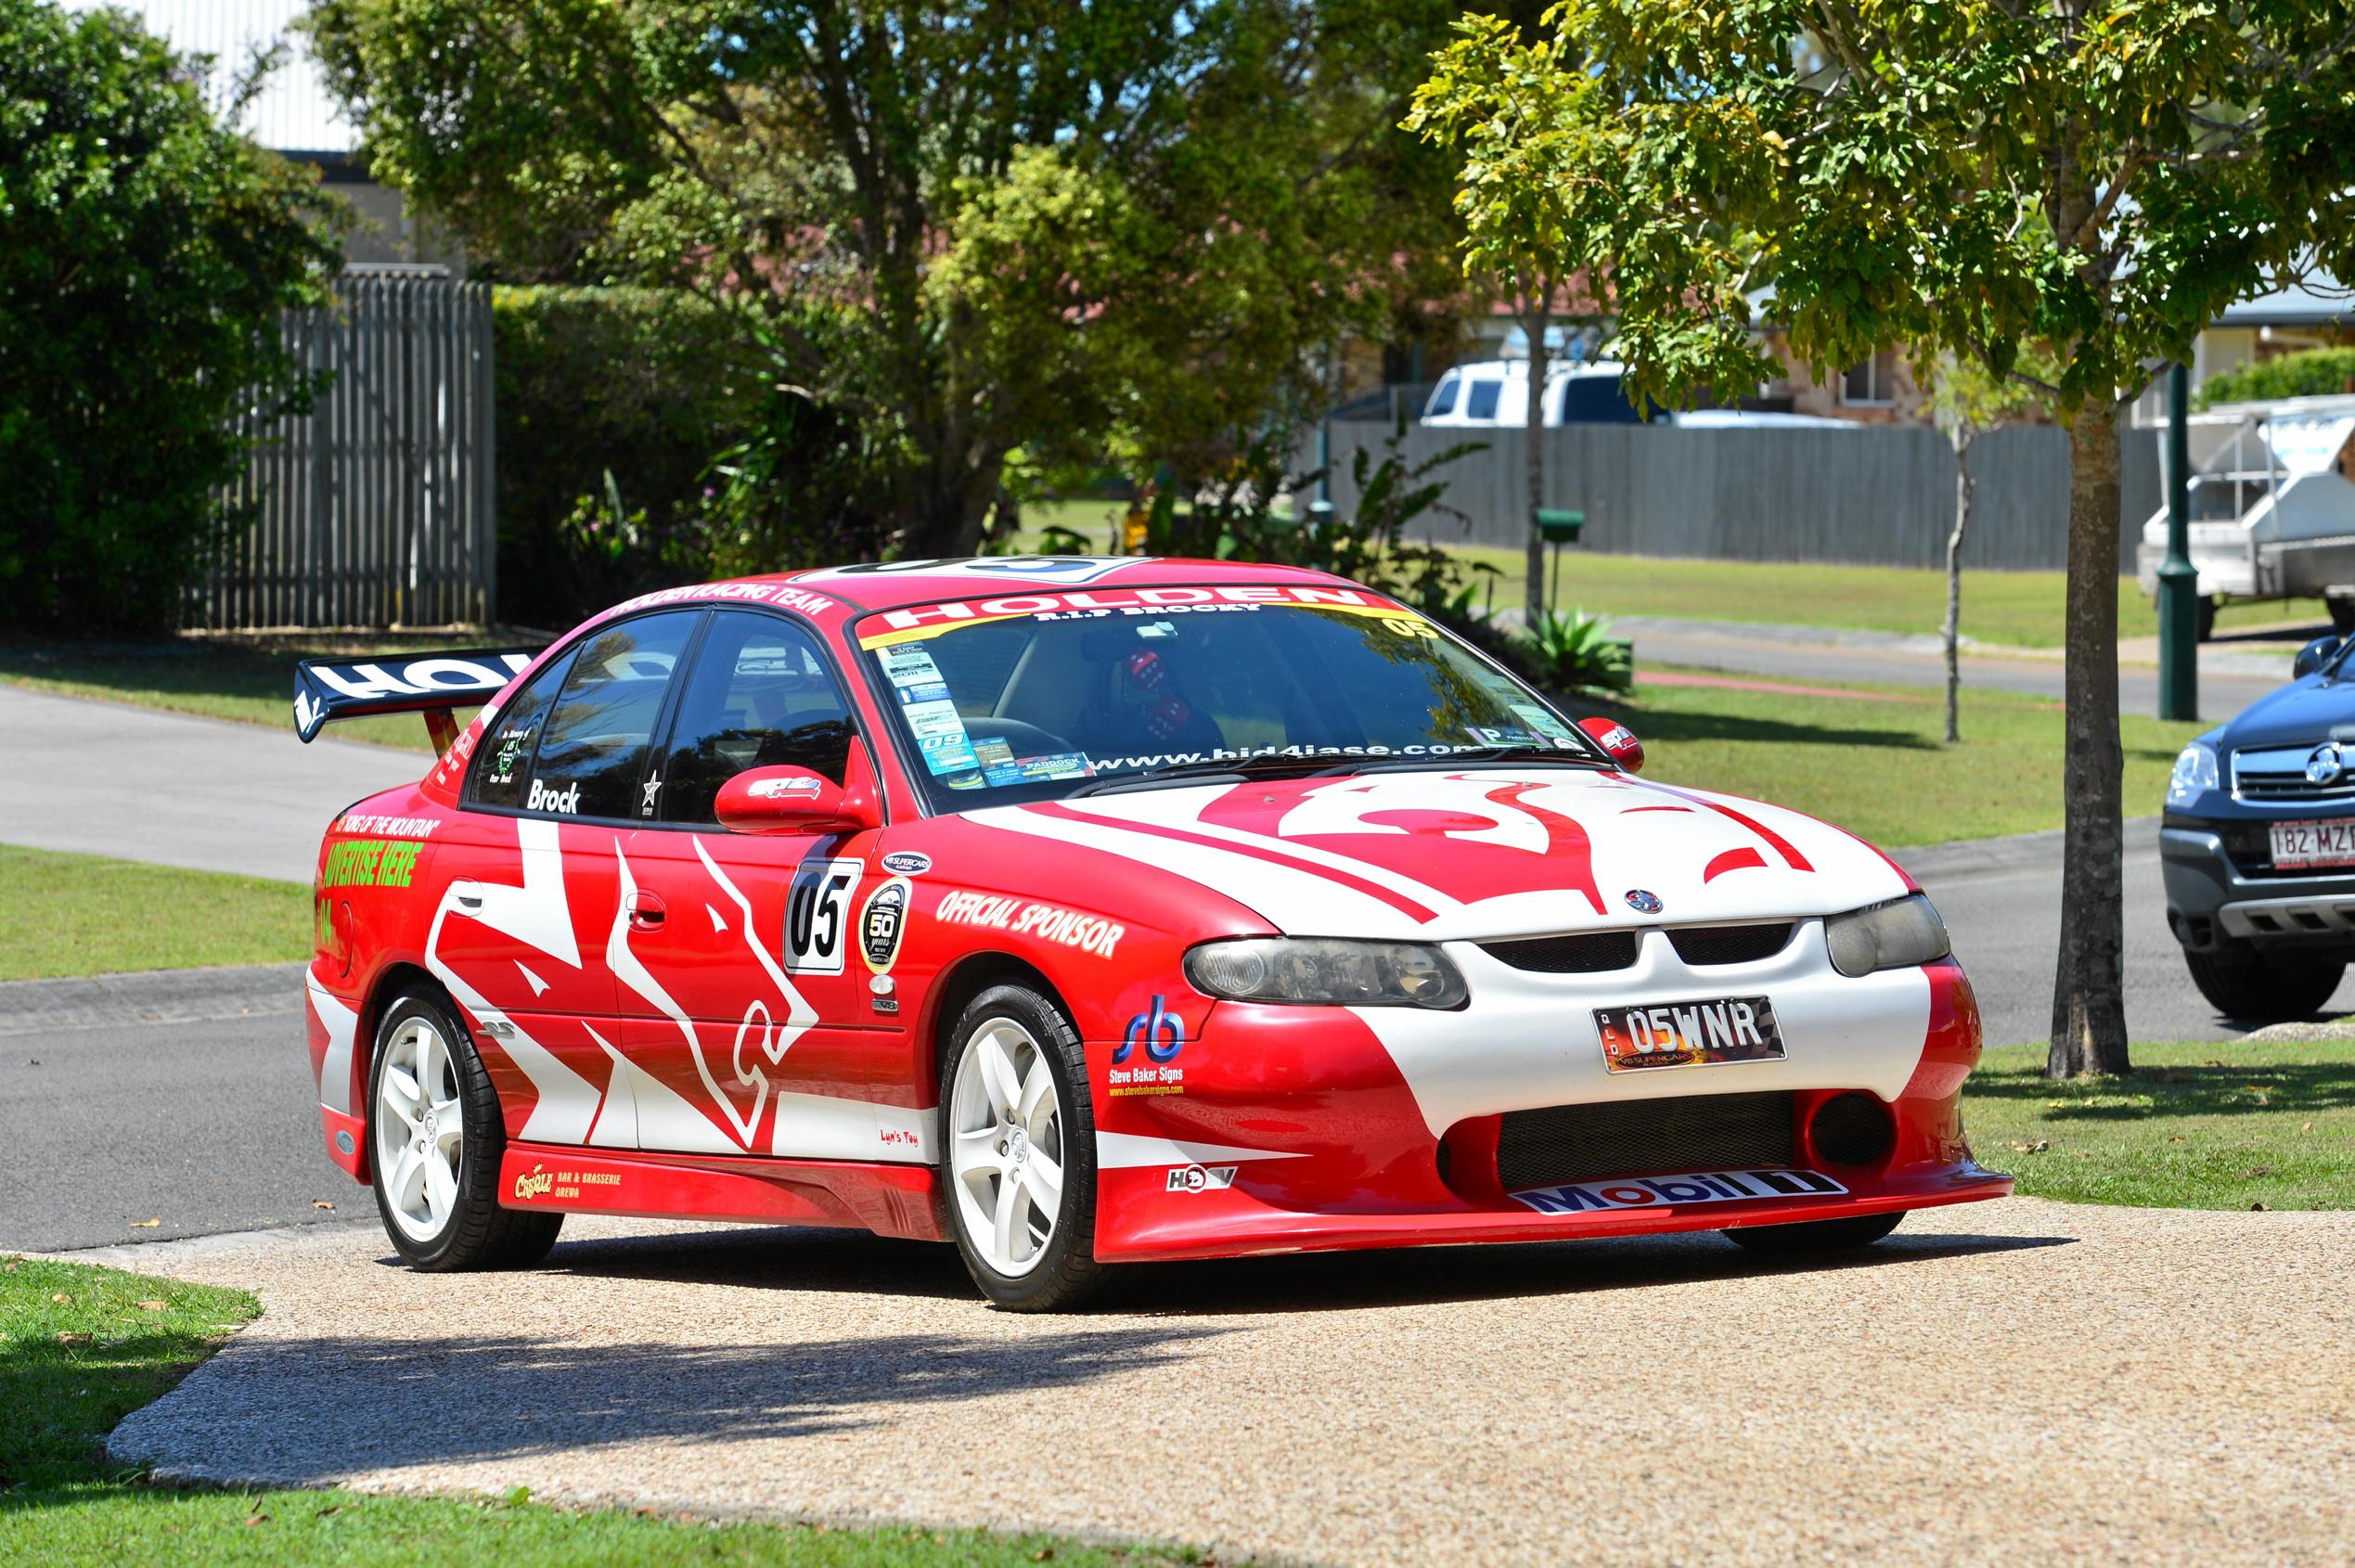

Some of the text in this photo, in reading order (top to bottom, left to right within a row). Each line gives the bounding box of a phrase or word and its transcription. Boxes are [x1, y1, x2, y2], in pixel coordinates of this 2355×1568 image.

[694, 583, 778, 600] RACING
[770, 586, 834, 616] TEAM
[882, 586, 1368, 629] HOLDEN
[1033, 602, 1261, 622] R.I.P BROCKY
[1382, 618, 1439, 639] 05
[893, 671, 920, 679] 2011
[922, 733, 964, 751] 09
[1479, 727, 1501, 742] P
[1026, 757, 1081, 769] PADDOCK
[527, 778, 581, 815] Brock
[370, 816, 393, 835] THE
[376, 840, 424, 888] HERE
[791, 872, 852, 958] 05
[935, 890, 1022, 929] OFFICIAL
[1010, 904, 1126, 958] SPONSOR
[869, 914, 895, 938] 50
[870, 936, 891, 953] years
[1601, 1013, 1620, 1057] QLD
[1626, 1001, 1764, 1055] 05WNR
[1109, 1066, 1184, 1085] Steve Baker Signs
[1109, 1085, 1185, 1098] www.stevebakersigns.com
[880, 1129, 902, 1146] Lyn's
[557, 1172, 622, 1186] BAR & BRASSERIE
[1514, 1172, 1759, 1214] Mobil
